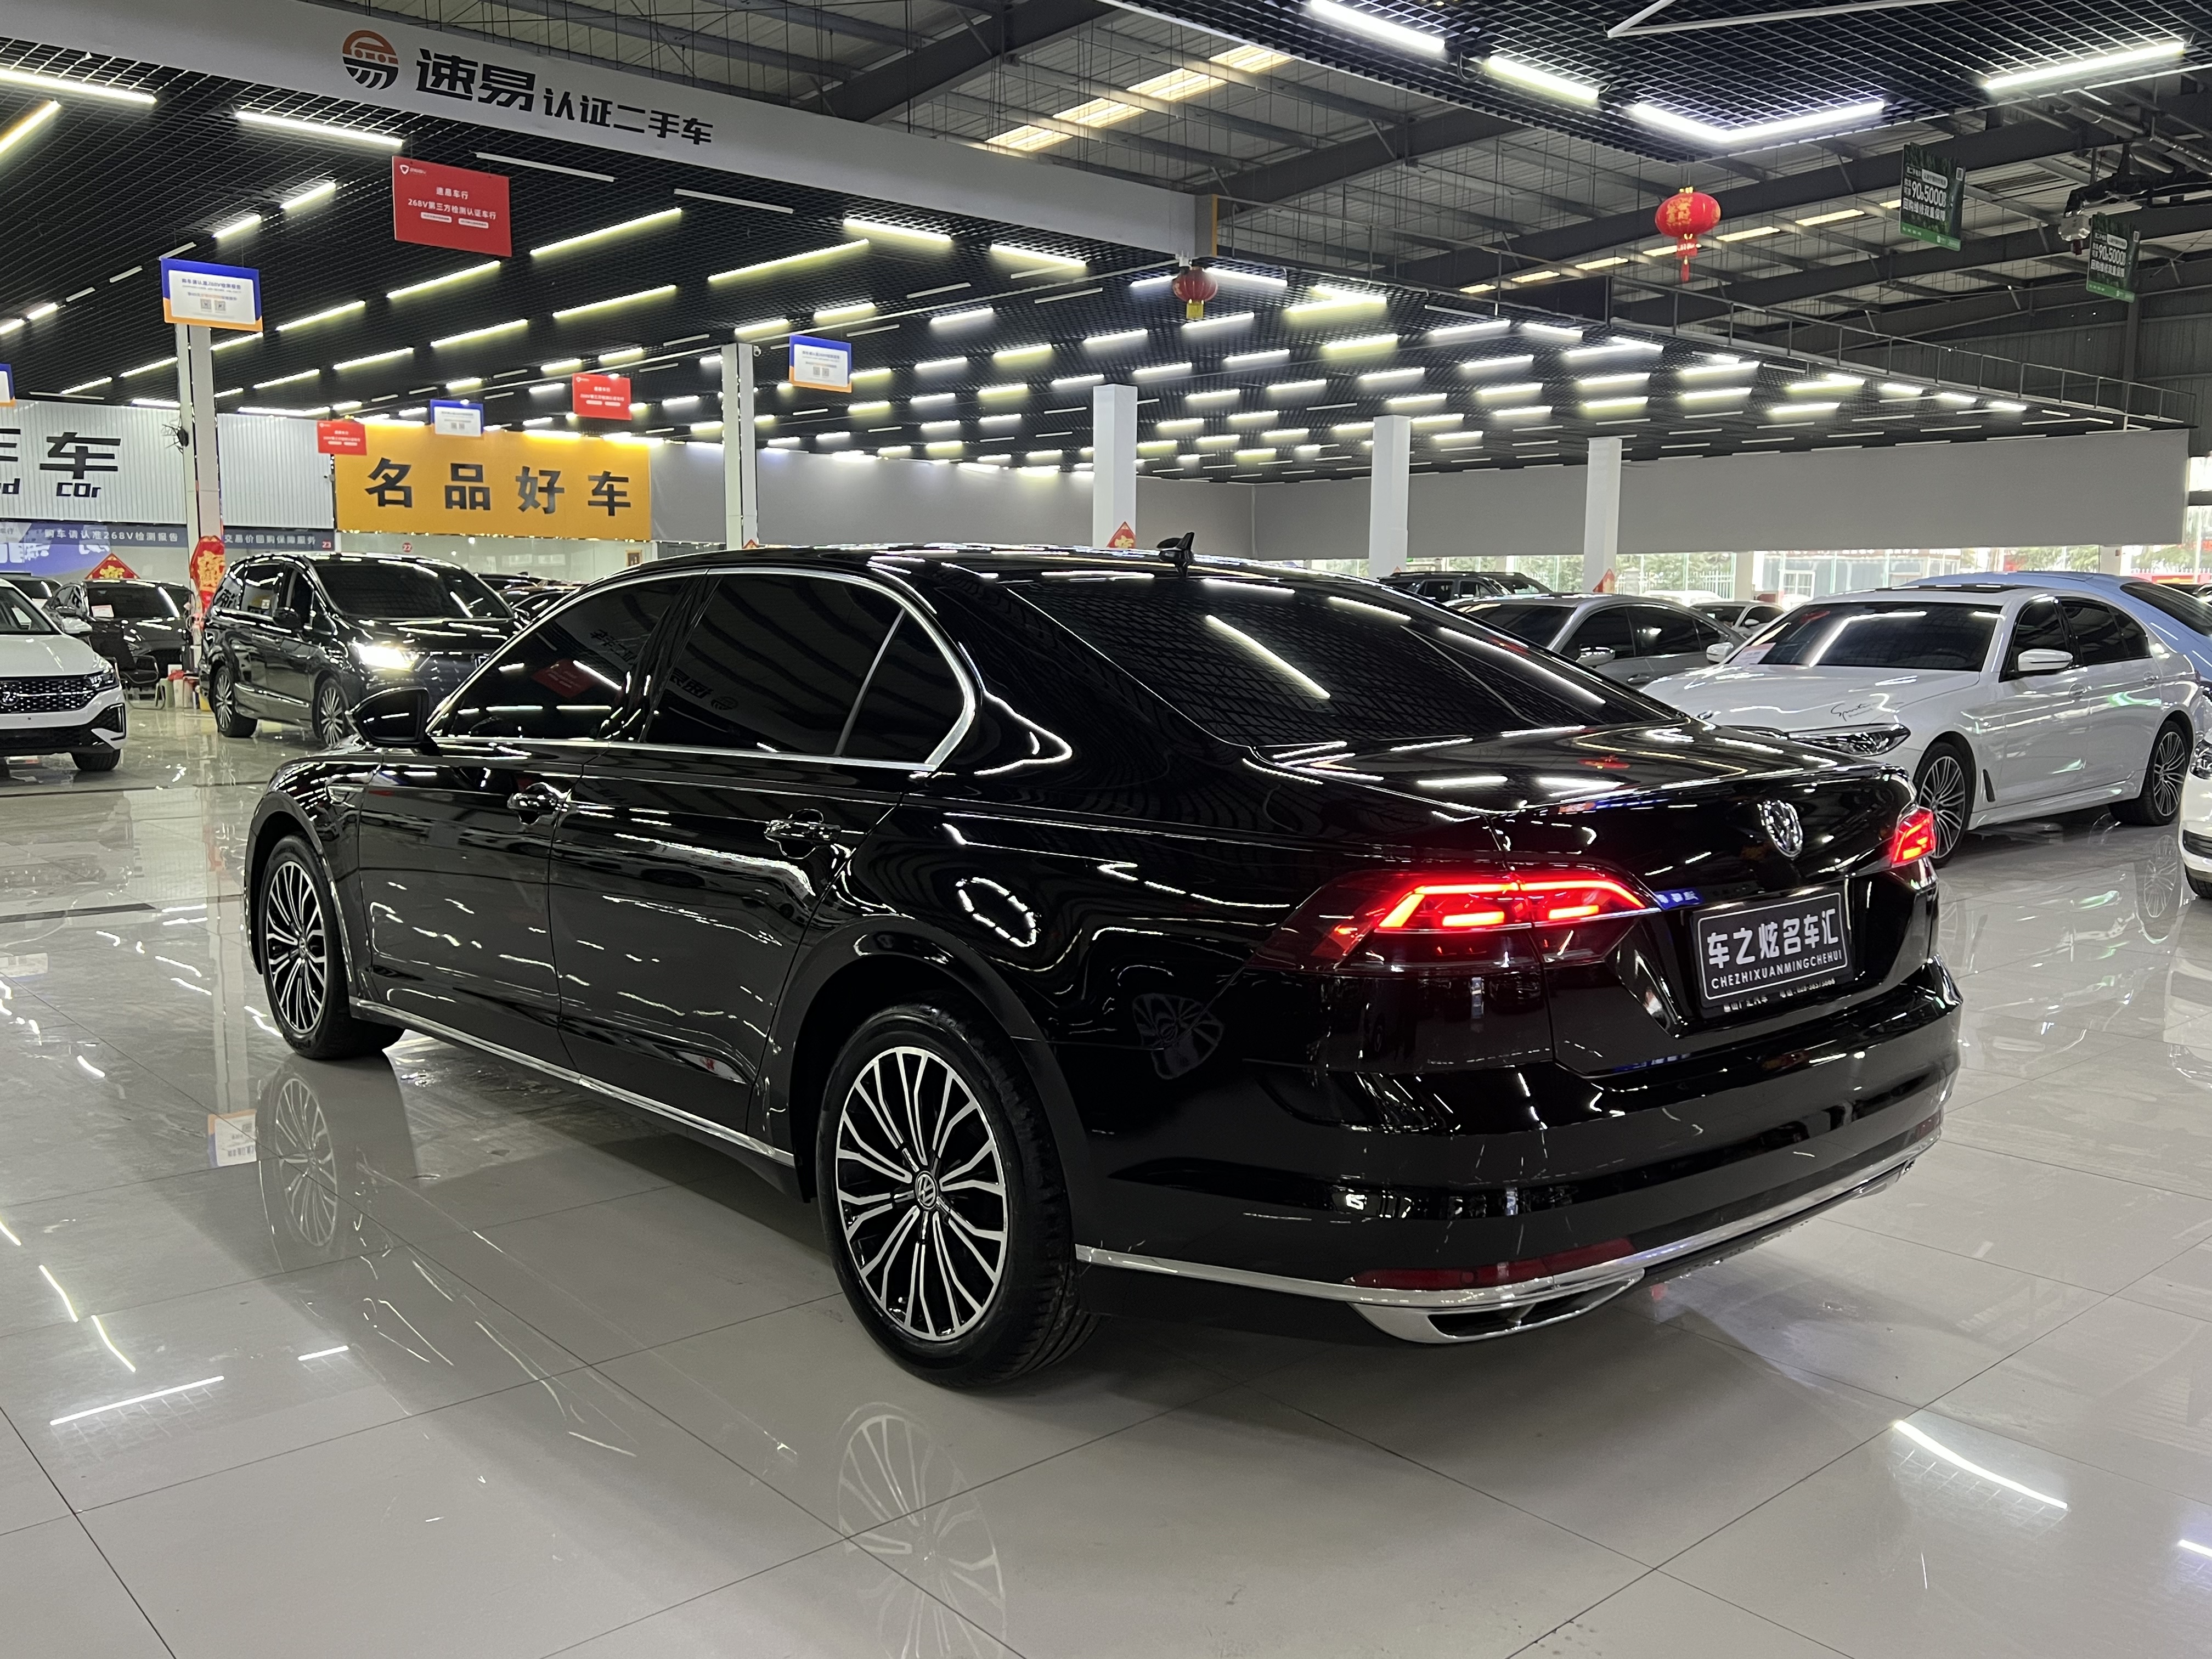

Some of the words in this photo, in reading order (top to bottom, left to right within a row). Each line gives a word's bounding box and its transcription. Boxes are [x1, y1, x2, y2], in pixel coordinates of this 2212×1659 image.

[415, 48, 536, 112] 速易
[543, 87, 714, 146] 认证二手车
[0, 428, 121, 479] 车
[365, 458, 631, 516] 名品好车
[44, 528, 178, 543] 购车请认准268V检测报告
[224, 534, 316, 545] 交易价回购保障服务
[1707, 909, 1838, 969] 车之炫名车汇
[1711, 949, 1843, 989] CHEZHIXUANMINGCHEHUI
